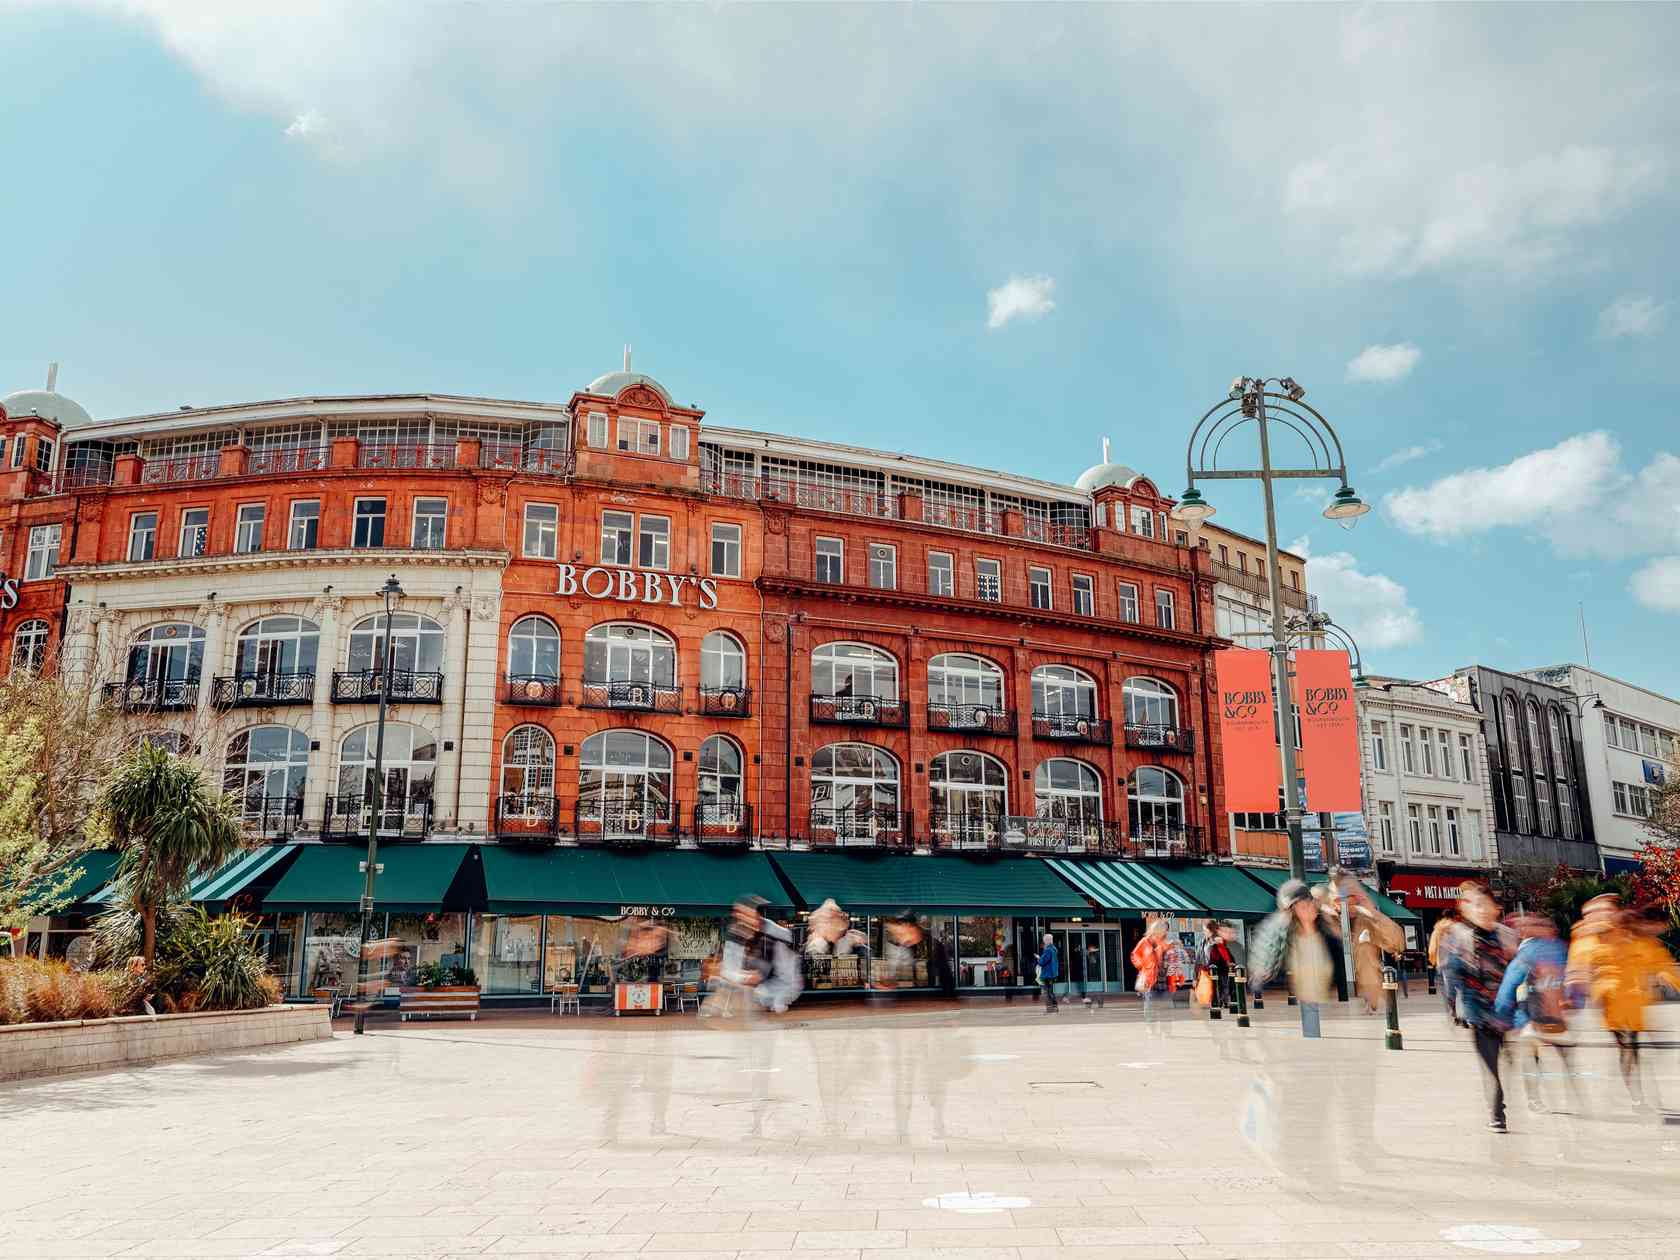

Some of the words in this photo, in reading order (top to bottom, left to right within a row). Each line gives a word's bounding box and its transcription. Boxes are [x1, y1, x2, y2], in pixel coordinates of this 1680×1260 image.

[555, 563, 718, 609] BOBBY'S
[1224, 690, 1267, 704] BOBBY
[1305, 687, 1349, 701] BOBBY
[1424, 886, 1437, 899] PRET
[1438, 886, 1443, 899] A
[620, 905, 649, 916] BOBBY
[651, 906, 659, 916] &
